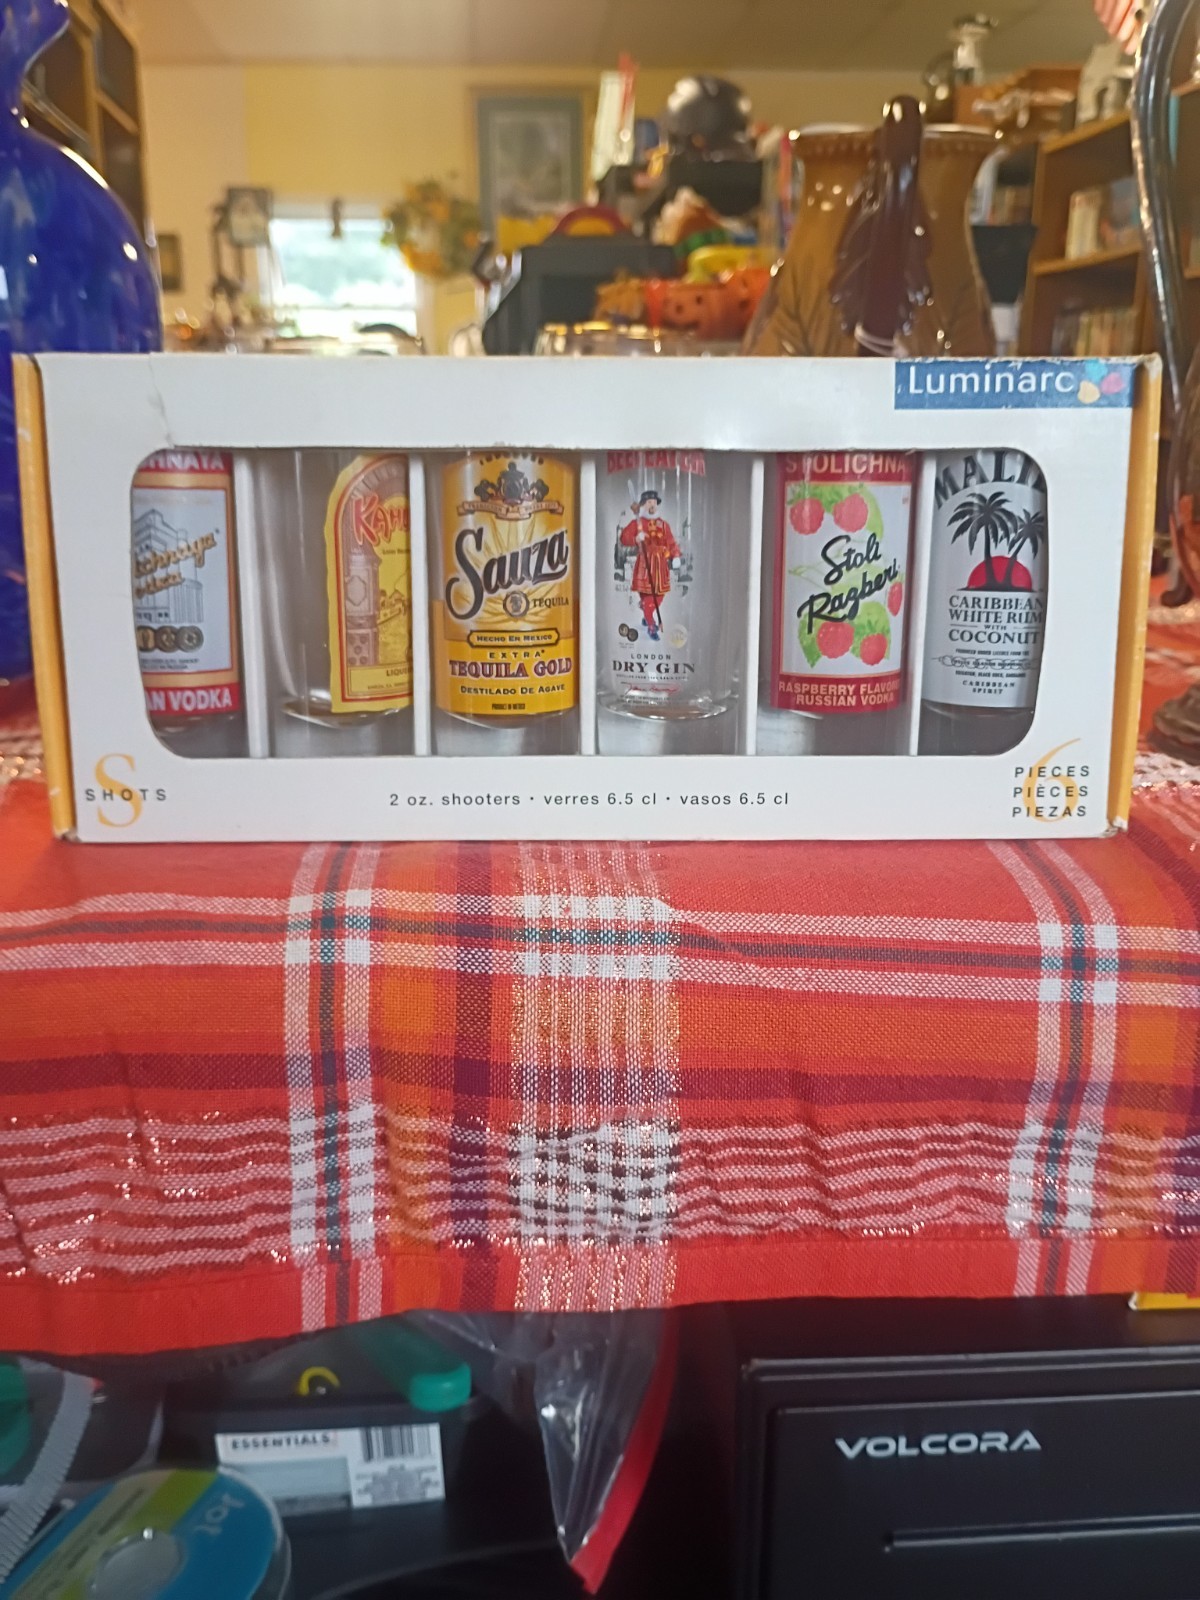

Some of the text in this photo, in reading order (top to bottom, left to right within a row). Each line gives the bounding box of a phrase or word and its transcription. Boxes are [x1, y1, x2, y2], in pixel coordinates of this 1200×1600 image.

[909, 363, 1075, 394] Luminarc
[820, 532, 882, 586] Stoli
[445, 526, 569, 620] Sauza
[532, 597, 570, 609] TEQUILA
[948, 595, 1043, 611] CARIBBEAN
[948, 609, 1045, 624] WHITE RUM
[523, 634, 553, 642] MEXICO
[948, 629, 1040, 644] COCONUT
[489, 651, 541, 659] EXTRA
[449, 657, 573, 678] TEQUILA GOLD
[612, 660, 696, 674] DRY GIN
[460, 685, 517, 695] DESTILADO
[538, 683, 566, 693] AGAVE
[778, 680, 857, 696] RASPBERRY
[962, 680, 1015, 688] CARIBBEAN
[168, 687, 232, 712] VODKA
[796, 692, 895, 707] RUSSIAN VODKA
[1014, 765, 1090, 778] PIECES
[85, 788, 167, 802] SHOTS
[1013, 783, 1088, 798] PIÈCES
[389, 792, 789, 806] 2 oz. shooters verres 6.5 cl vasos 6.5 cl
[1012, 805, 1087, 818] PIEZAS
[232, 1432, 331, 1450] ESSENTIALS
[835, 1429, 1042, 1460] VOLCORA
